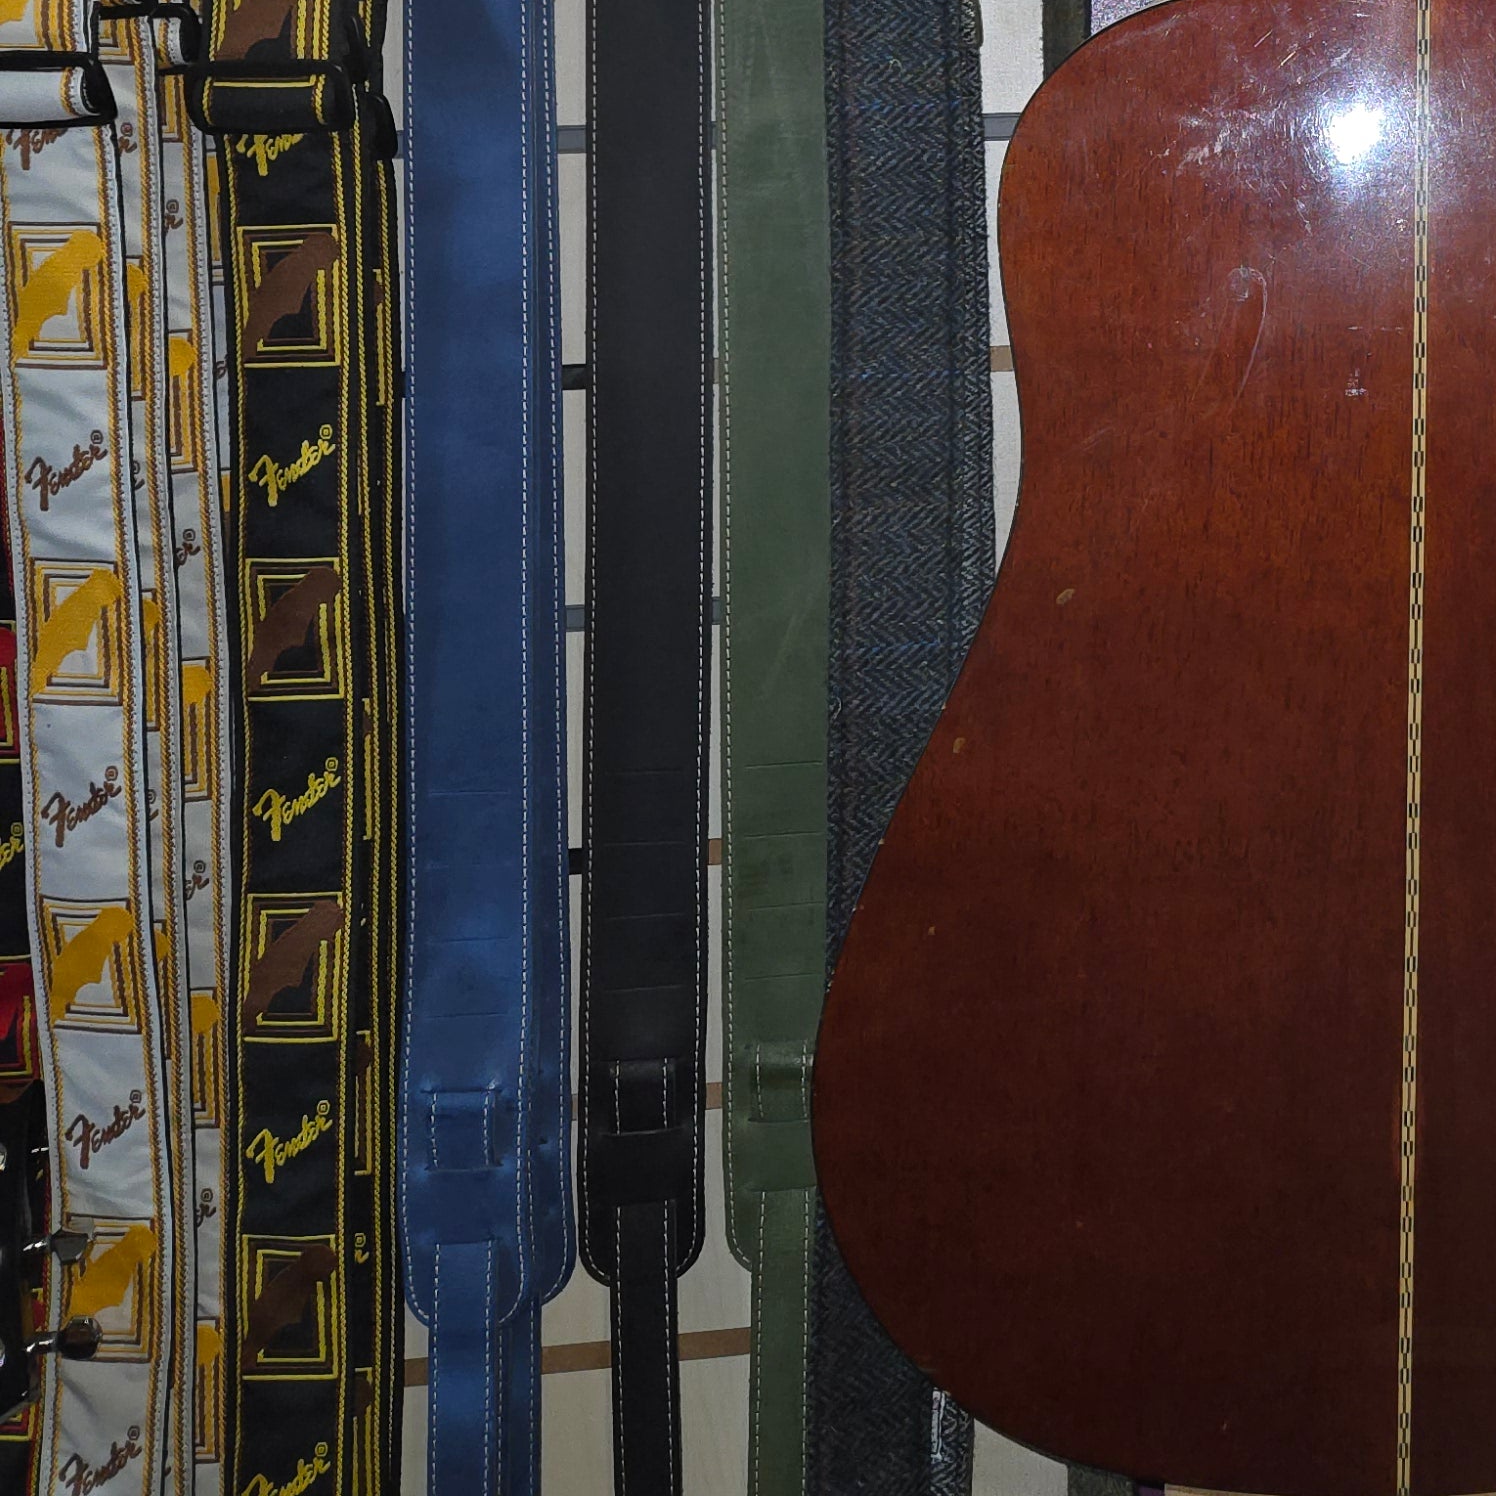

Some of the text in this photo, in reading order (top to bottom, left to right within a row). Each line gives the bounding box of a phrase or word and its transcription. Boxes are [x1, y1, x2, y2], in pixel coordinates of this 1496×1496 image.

[24, 442, 107, 511] Fender
[248, 438, 337, 508] Fender
[41, 779, 123, 848] Fender
[252, 771, 342, 842] Fender
[65, 1103, 147, 1171] Fender
[246, 1114, 333, 1184] Fender
